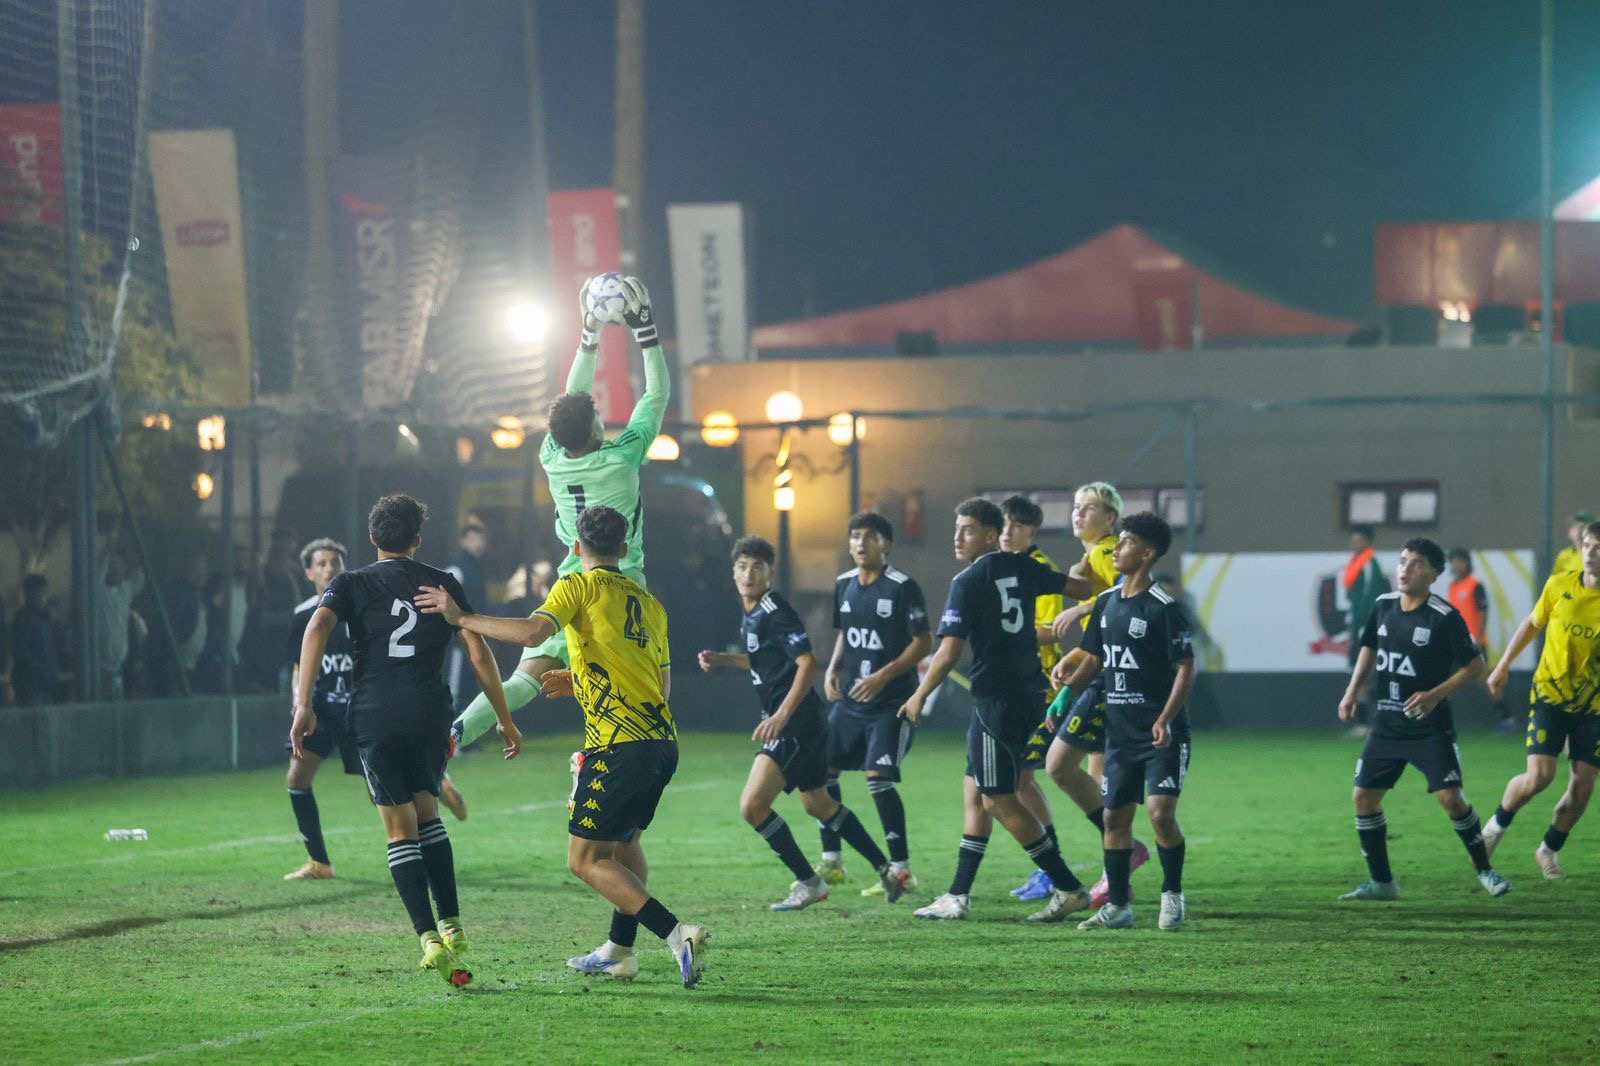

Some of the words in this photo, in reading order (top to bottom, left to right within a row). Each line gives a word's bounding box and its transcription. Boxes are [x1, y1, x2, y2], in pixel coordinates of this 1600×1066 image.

[567, 485, 585, 517] 1
[388, 598, 418, 657] 2
[623, 595, 650, 649] 4
[995, 577, 1025, 634] 5
[1067, 716, 1082, 733] 9
